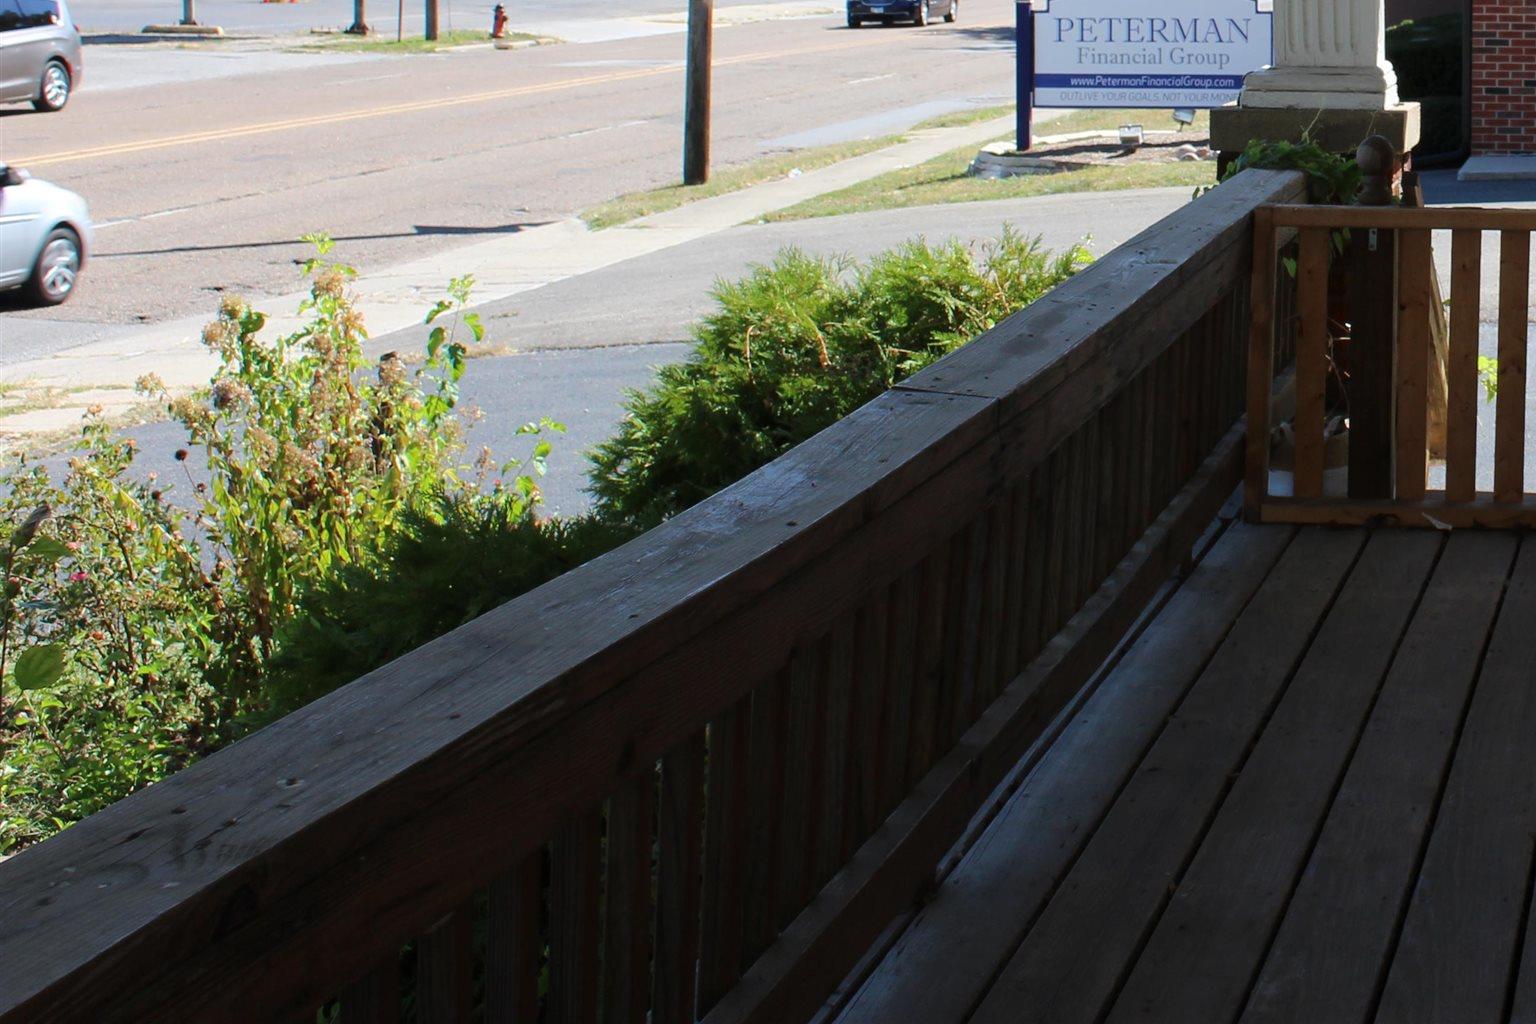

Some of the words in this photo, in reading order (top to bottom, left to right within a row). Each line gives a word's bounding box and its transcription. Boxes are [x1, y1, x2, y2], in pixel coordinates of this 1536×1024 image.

[1053, 17, 1251, 44] PETERMAN
[1076, 46, 1162, 65] Financial
[1169, 47, 1231, 70] Group
[1070, 75, 1234, 88] www.PetermanFinancialGroup.com
[1060, 90, 1100, 102] OUTLIVE
[1100, 90, 1127, 102] YOUR
[1162, 90, 1181, 102] NOT
[1183, 91, 1209, 103] YOUR
[1210, 91, 1239, 103] MONE
